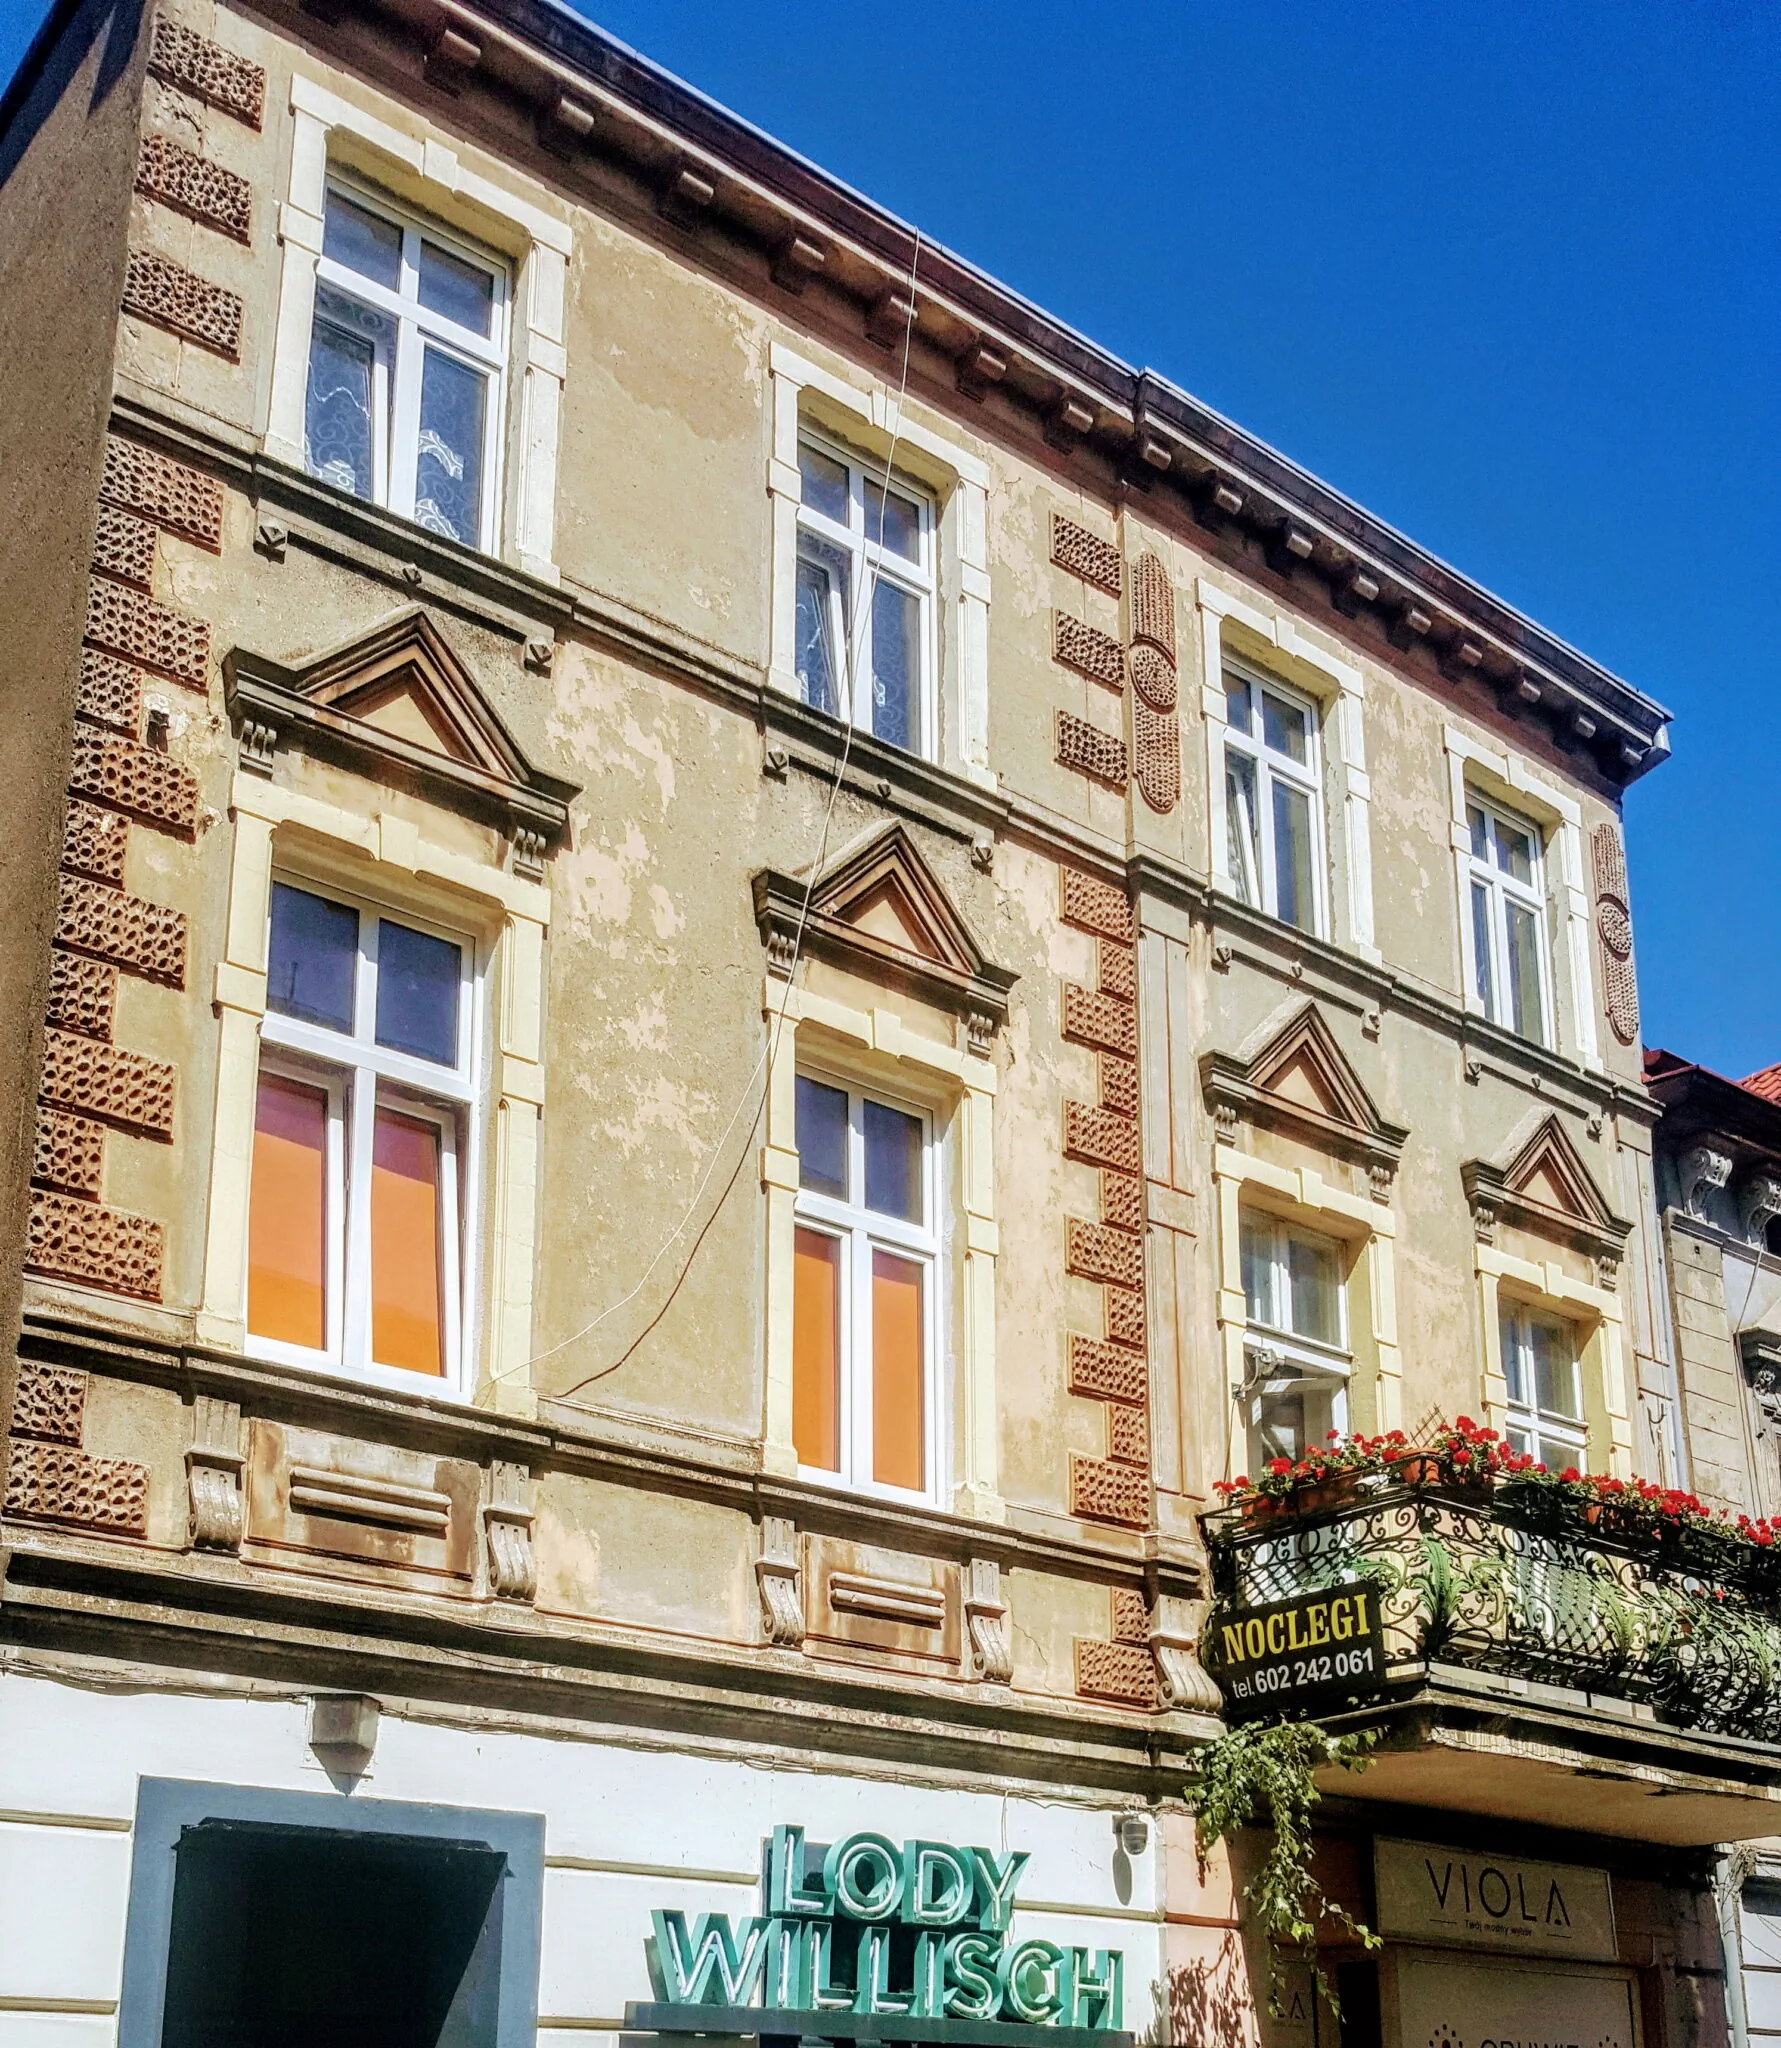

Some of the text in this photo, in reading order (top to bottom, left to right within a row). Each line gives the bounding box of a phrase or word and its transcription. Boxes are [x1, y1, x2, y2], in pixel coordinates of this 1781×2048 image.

[1222, 1594, 1370, 1664] NOCLEGI
[1232, 1647, 1374, 1699] tel. 602 242 061
[770, 1824, 1031, 1932] LODY
[1424, 1858, 1571, 1927] VIOLA
[650, 1909, 1124, 2030] WILLISCH
